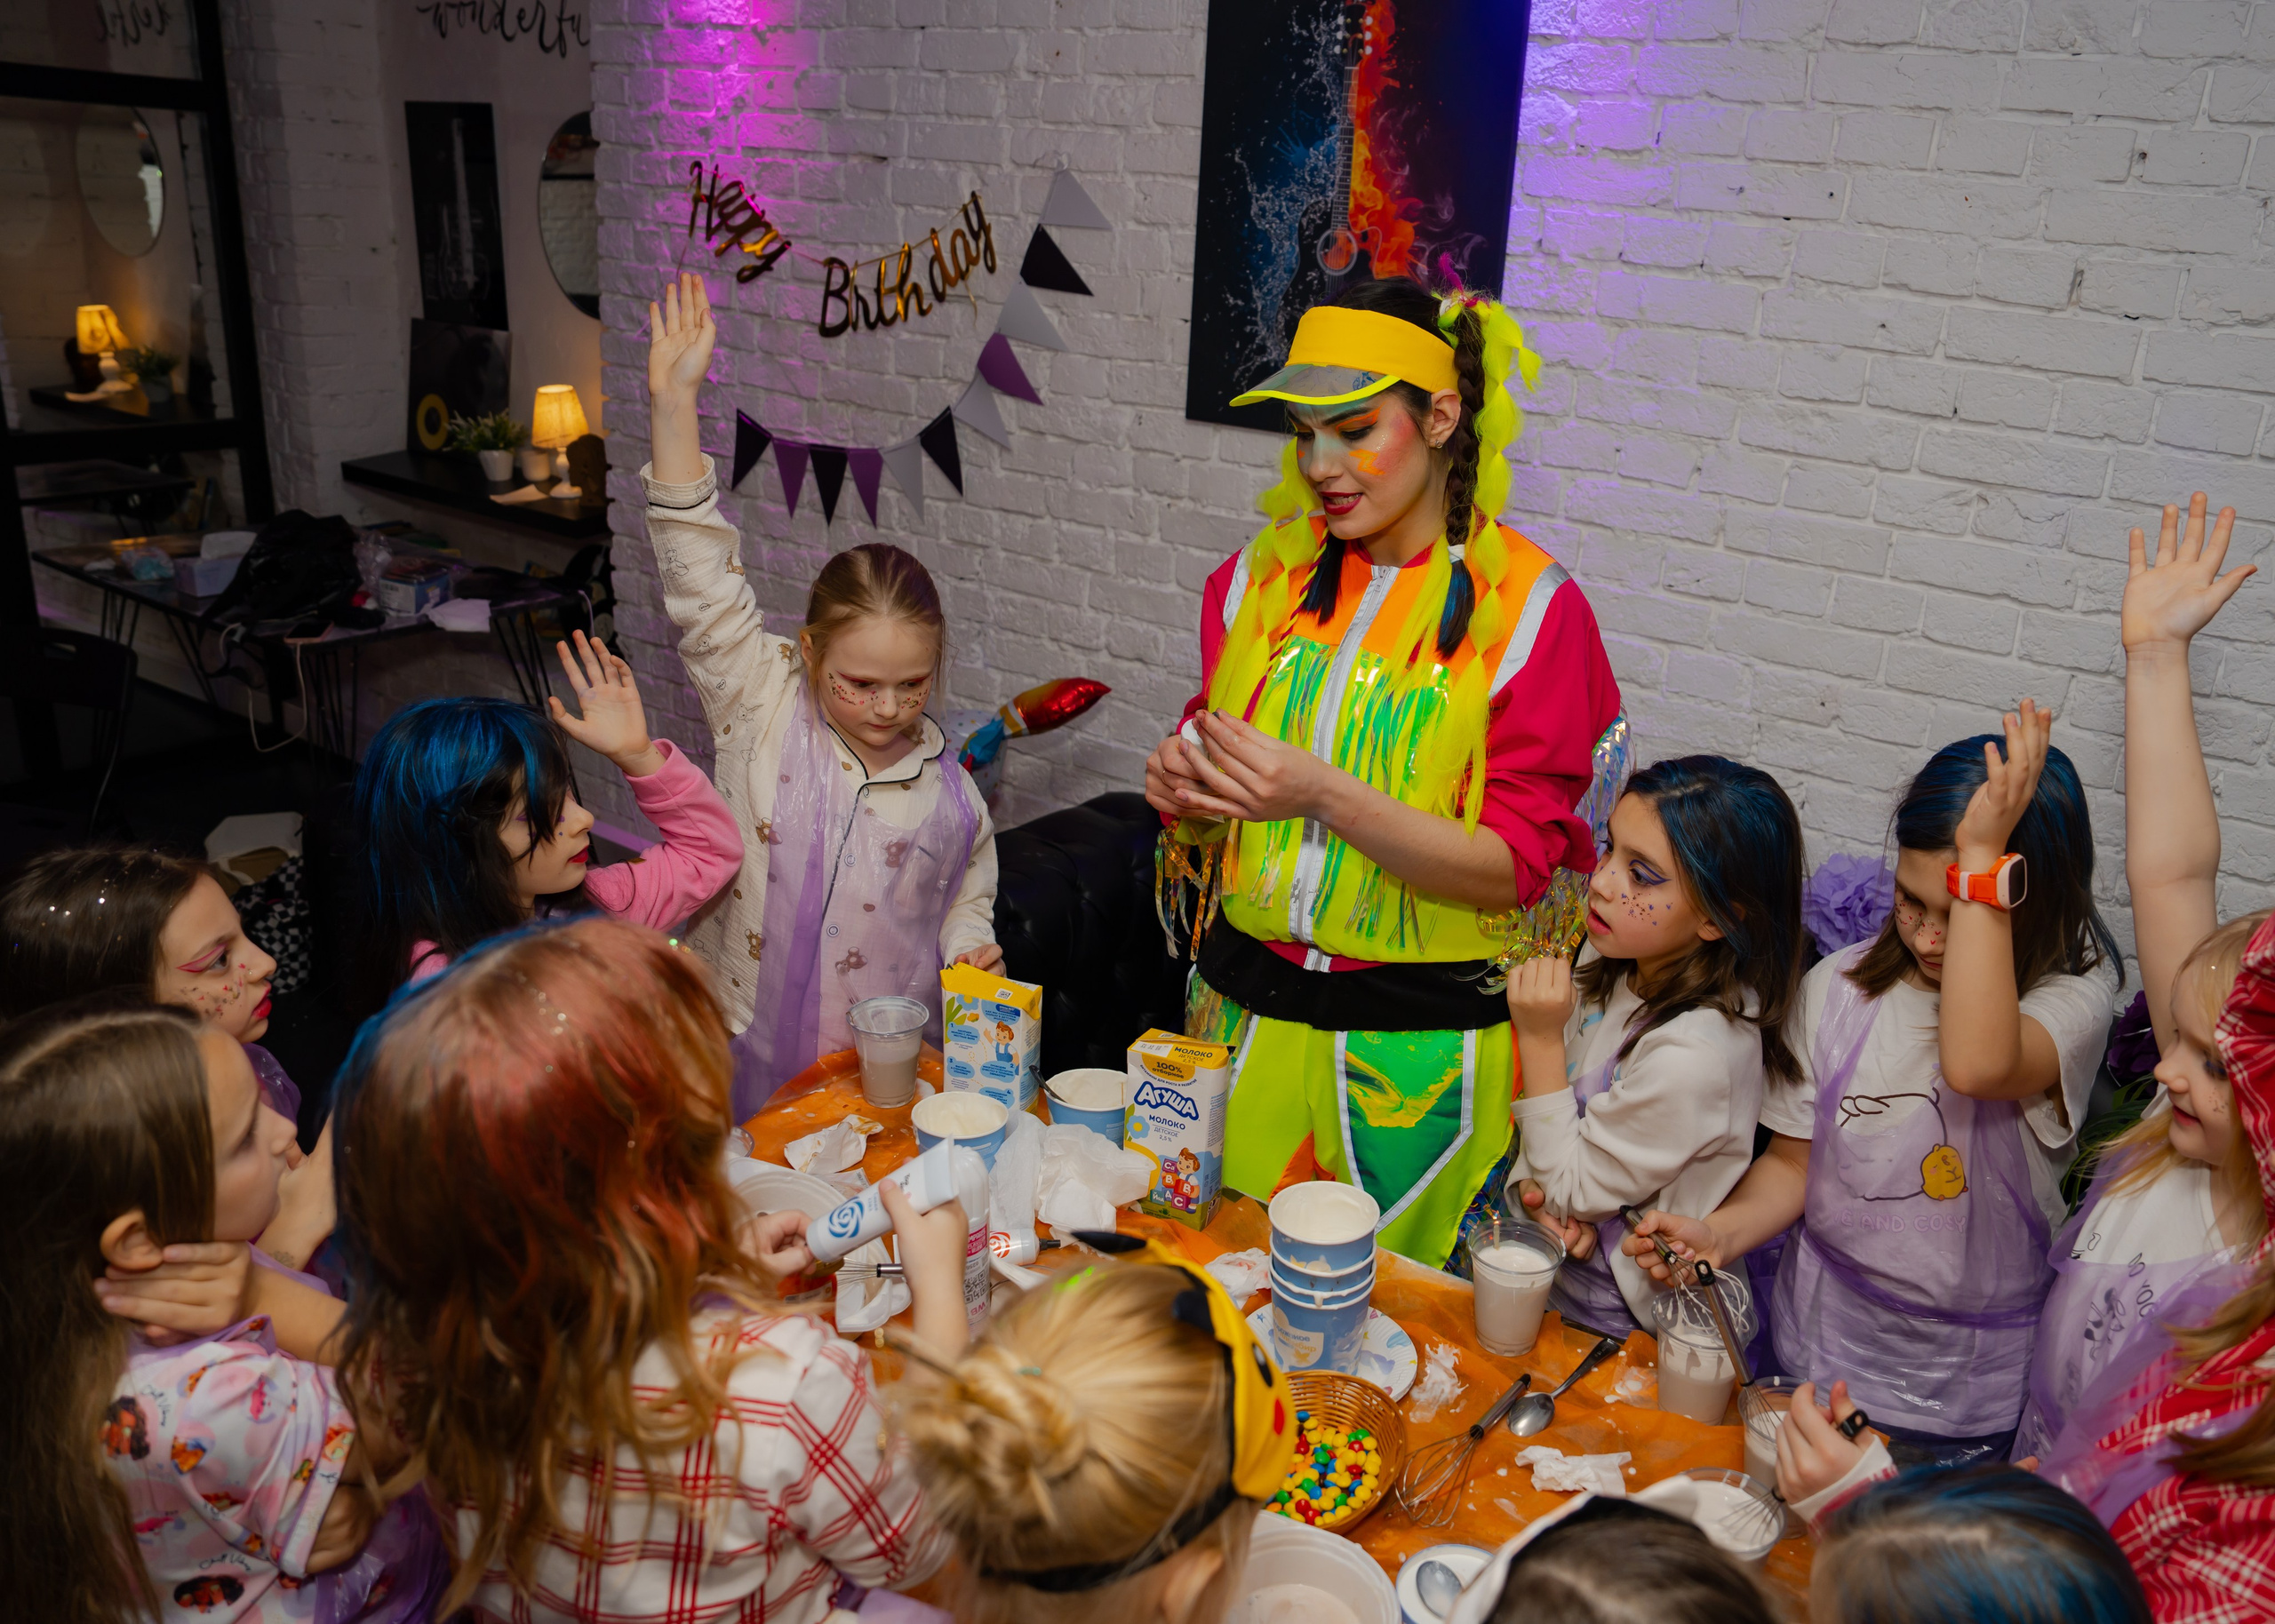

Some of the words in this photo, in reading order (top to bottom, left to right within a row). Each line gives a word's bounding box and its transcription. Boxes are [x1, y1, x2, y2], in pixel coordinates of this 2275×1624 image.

[416, 0, 590, 59] wonderfu
[688, 160, 792, 283] Happy
[818, 190, 997, 338] Birthday
[1174, 1047, 1213, 1058] МОЛОКО
[1152, 1067, 1185, 1079] отборное
[1156, 1062, 1183, 1073] 100%
[1149, 1114, 1186, 1130] МОЛОКО
[1153, 1126, 1178, 1137] ДЕТСКОЕ
[1164, 1162, 1175, 1171] Ca
[1174, 1197, 1184, 1207] C
[1860, 1213, 1905, 1233] AND
[1913, 1213, 1967, 1234] COSY
[970, 1302, 986, 1317] WB
